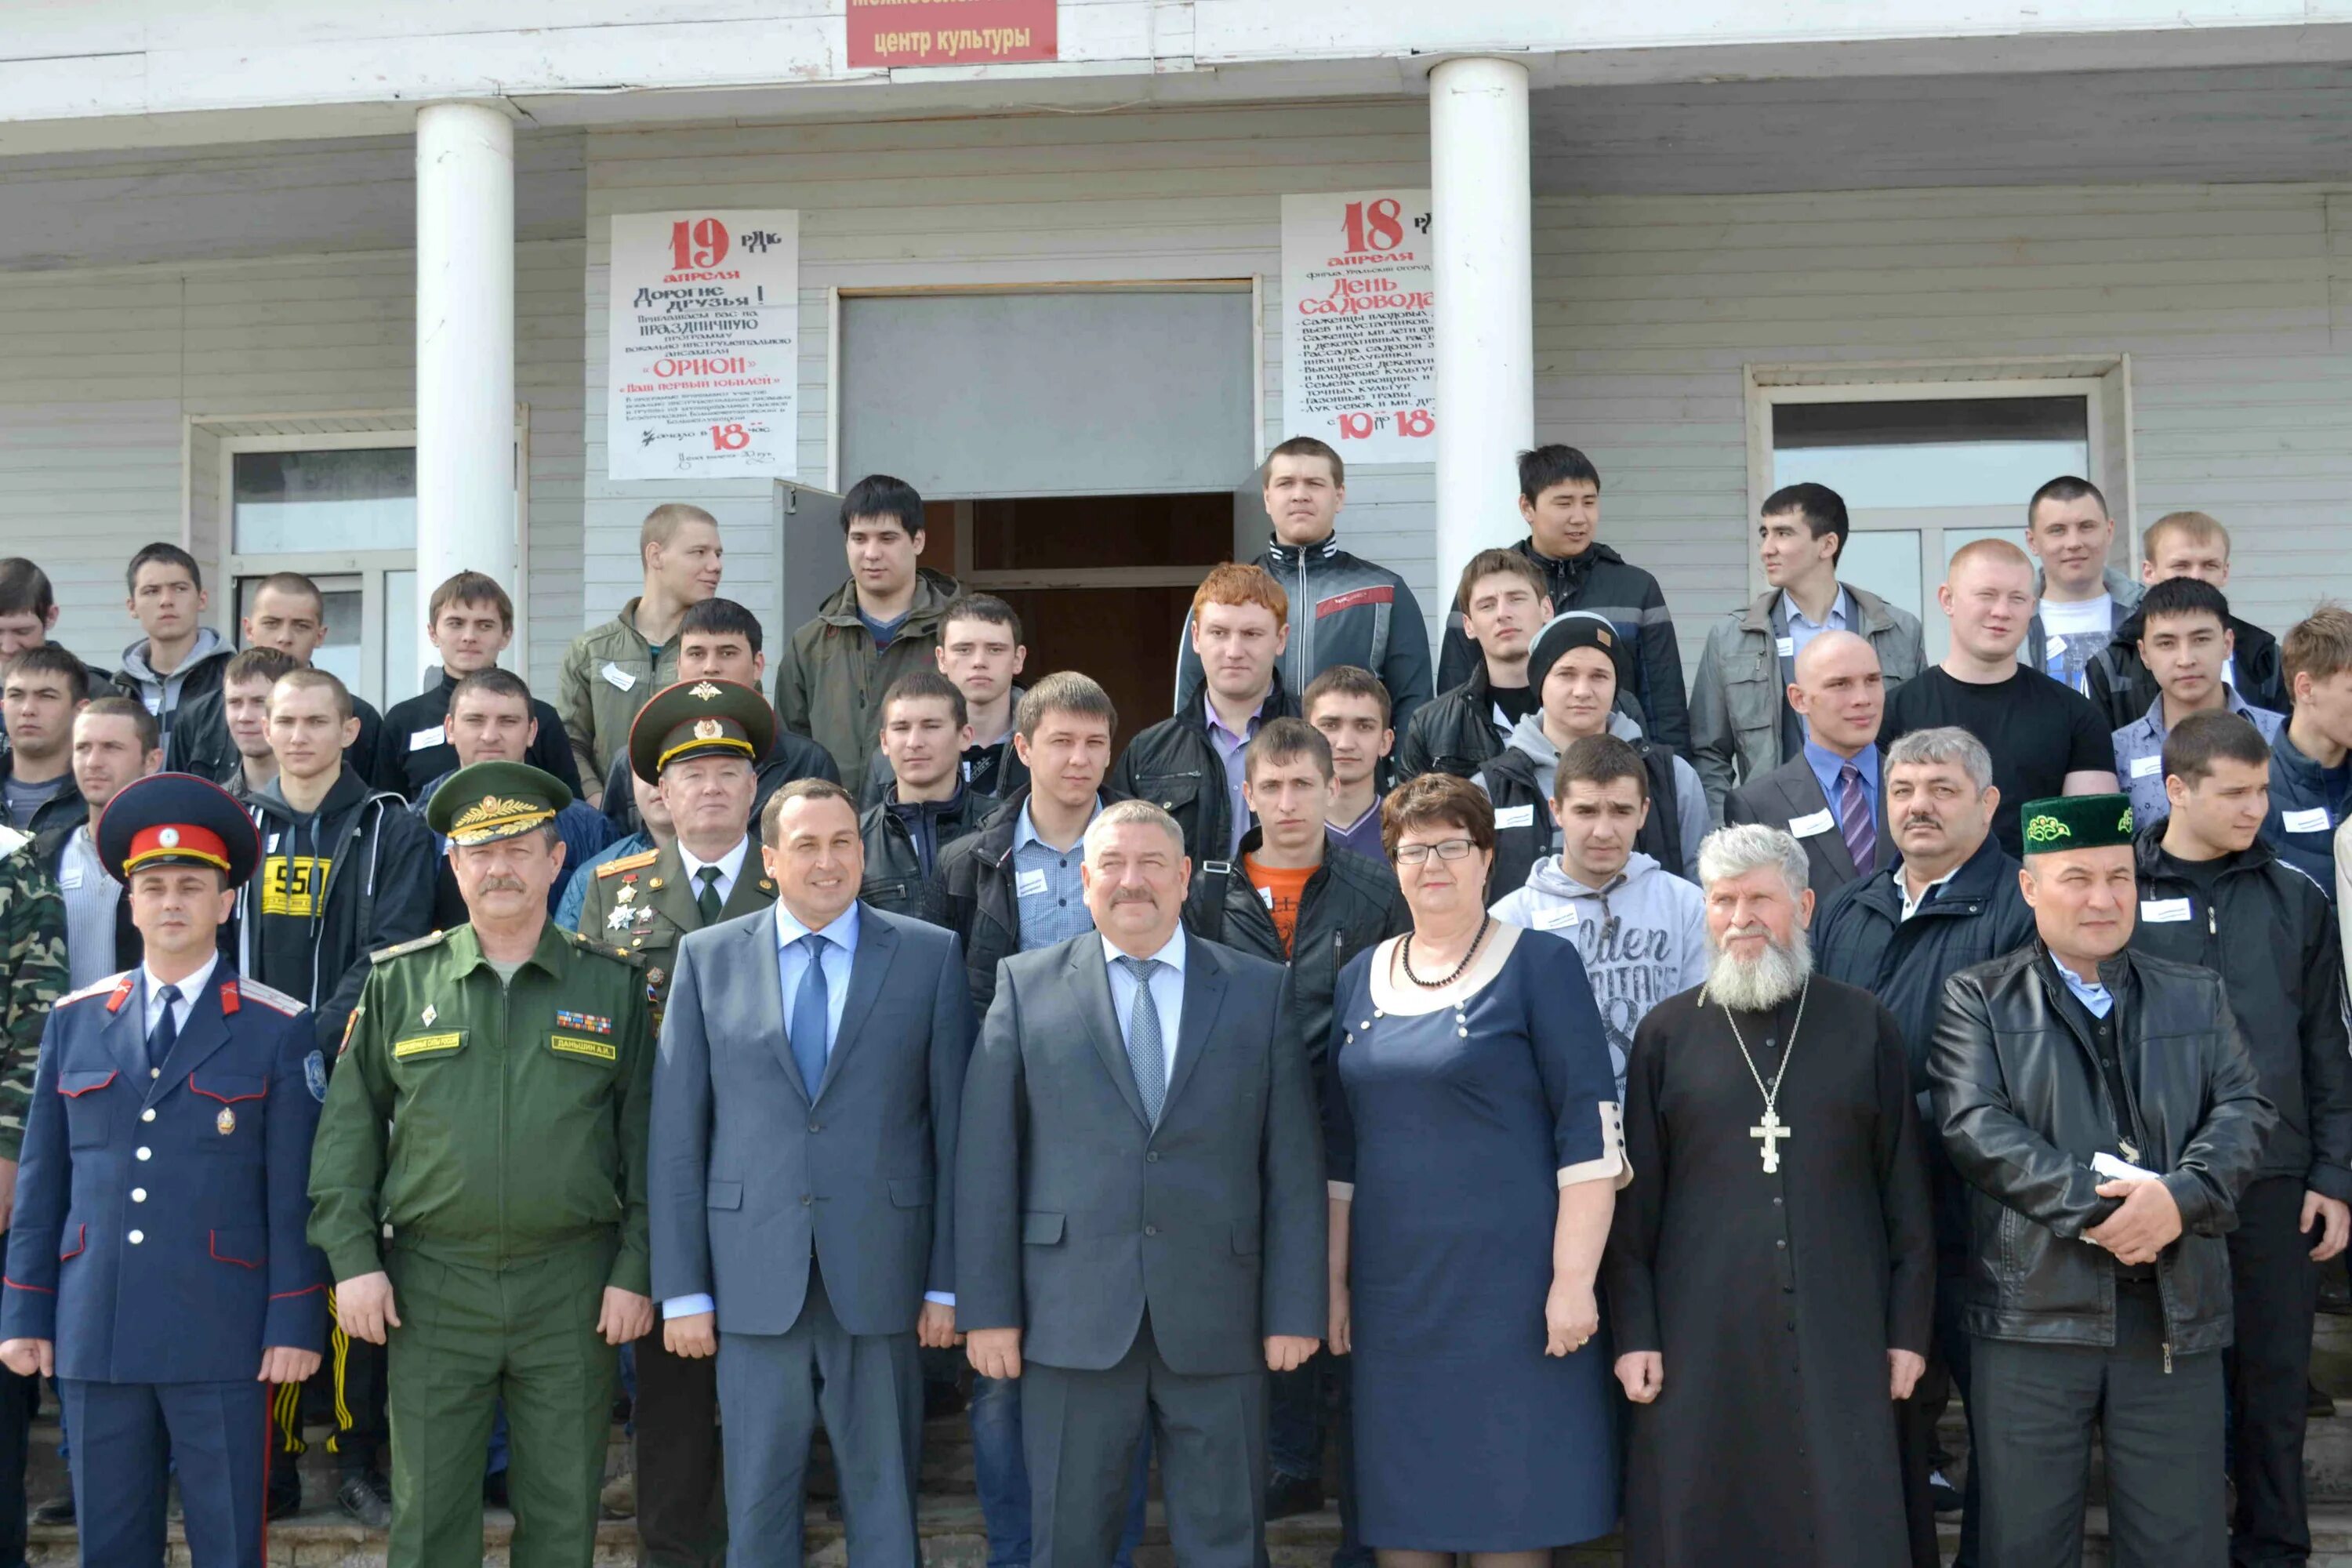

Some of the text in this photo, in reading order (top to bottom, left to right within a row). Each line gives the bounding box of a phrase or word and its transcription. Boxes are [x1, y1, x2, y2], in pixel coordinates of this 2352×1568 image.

[874, 27, 1030, 57] центр культуры
[1341, 198, 1403, 253] 18
[669, 218, 729, 270] 19
[1327, 252, 1414, 267] апреля
[1330, 278, 1398, 299] День
[709, 423, 750, 451] 18
[1337, 412, 1374, 439] 10
[1393, 409, 1436, 437] 18
[557, 1040, 596, 1052] ДАНЬШИН
